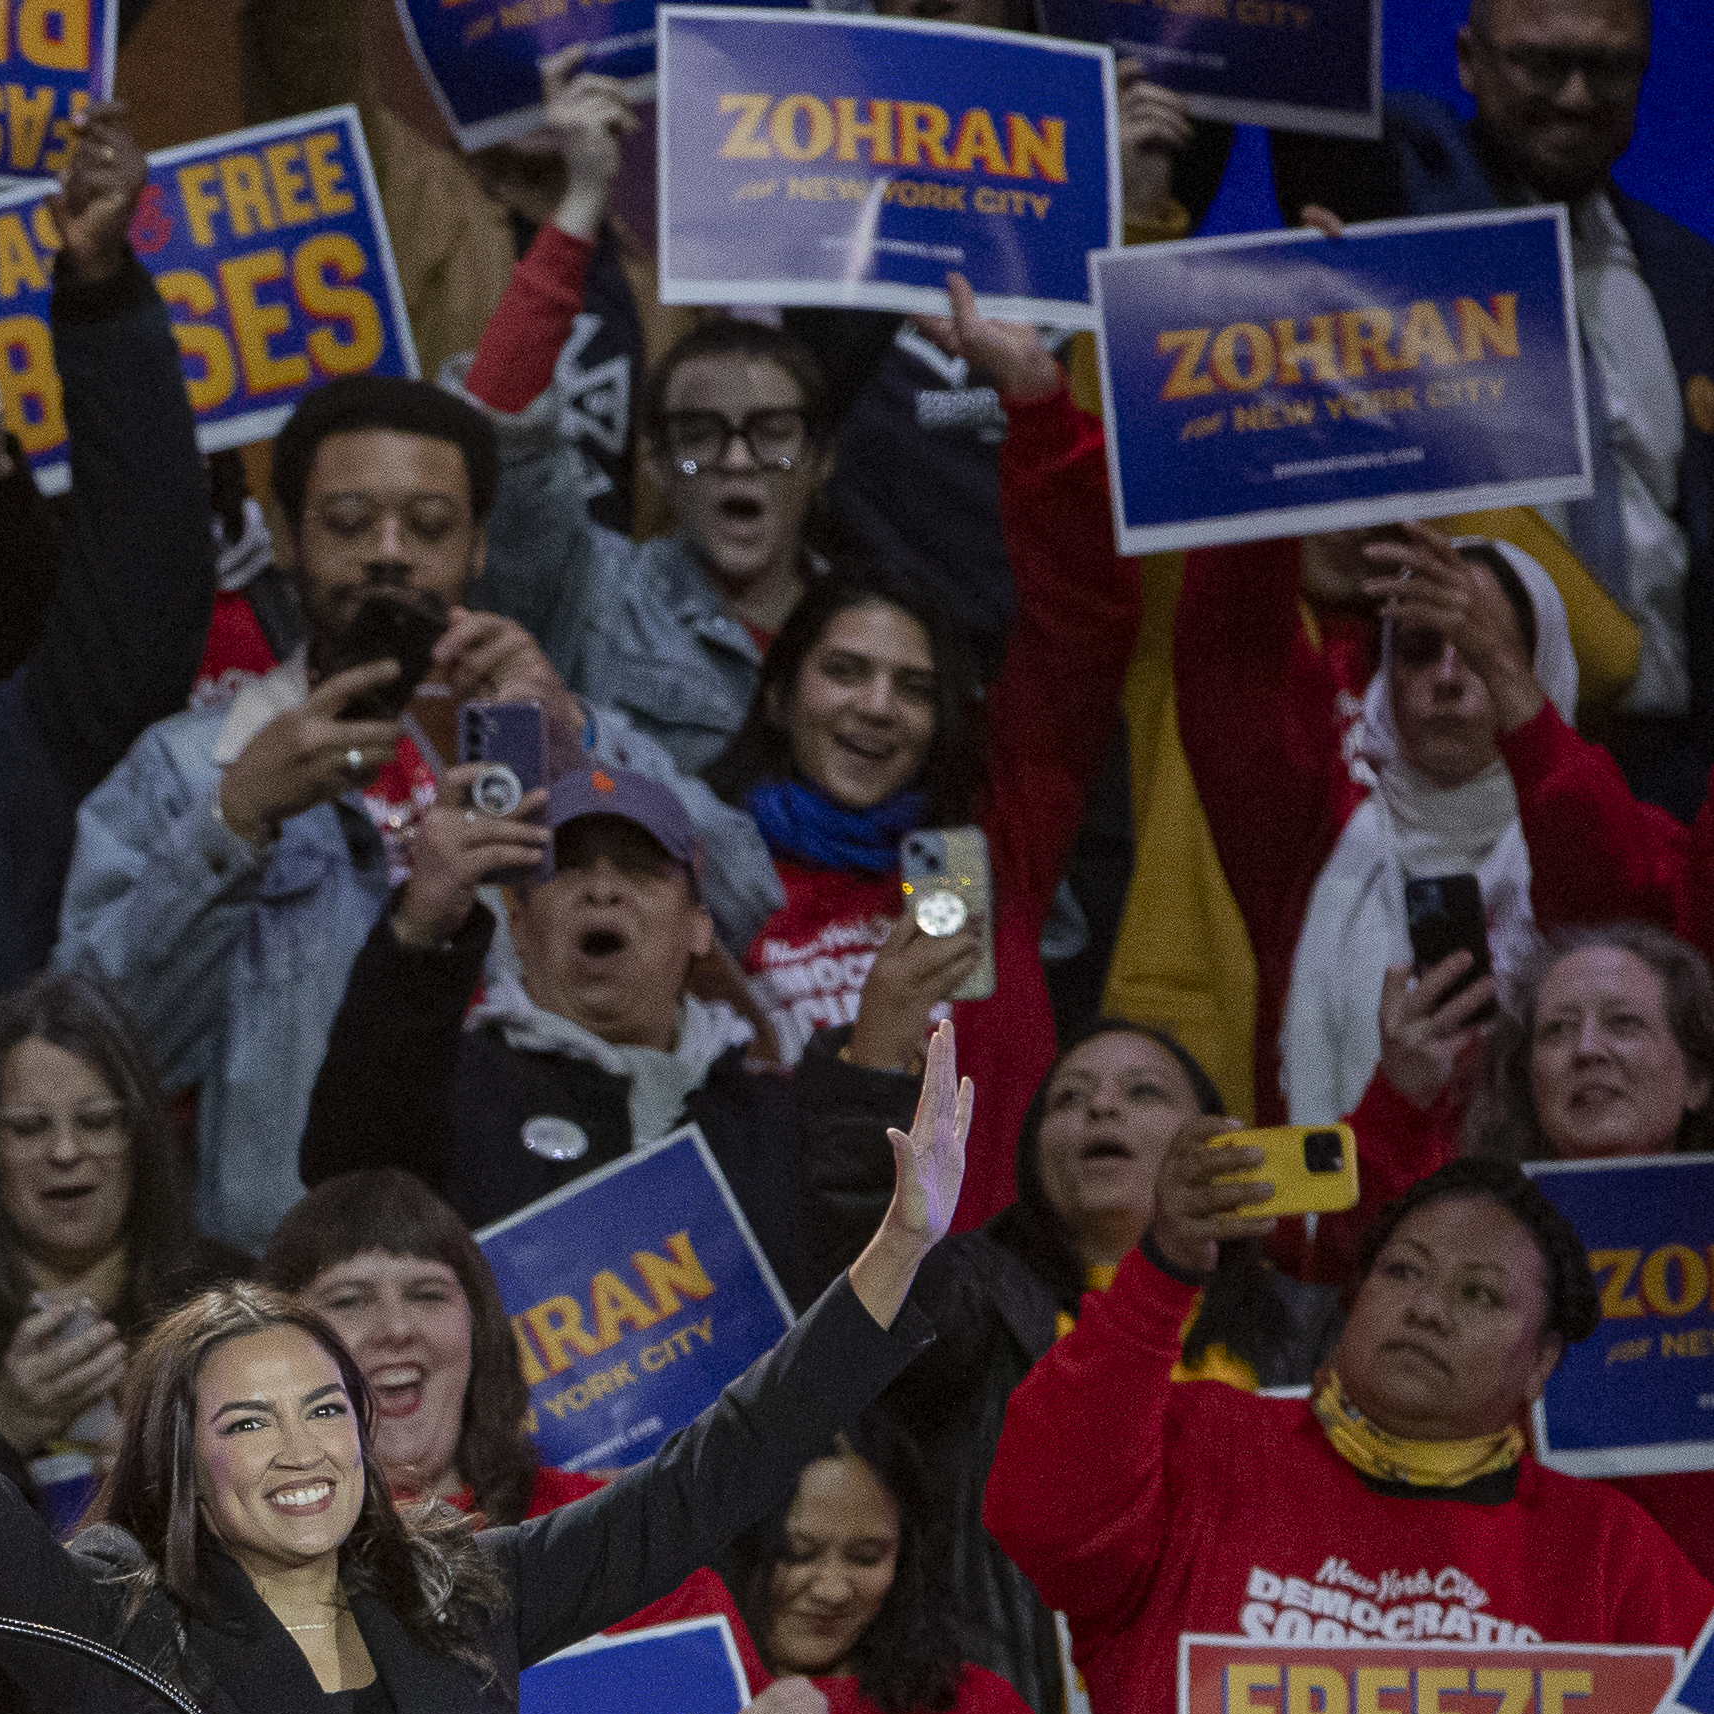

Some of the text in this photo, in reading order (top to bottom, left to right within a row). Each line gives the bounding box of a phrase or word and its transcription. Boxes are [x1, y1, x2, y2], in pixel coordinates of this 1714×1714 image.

[719, 92, 1068, 183] ZOHRAN
[177, 132, 355, 247] FREE
[973, 186, 1052, 220] CITY
[1155, 291, 1521, 401] ZOHRAN
[1232, 400, 1315, 432] NEW
[542, 1316, 714, 1420] YORK CITY
